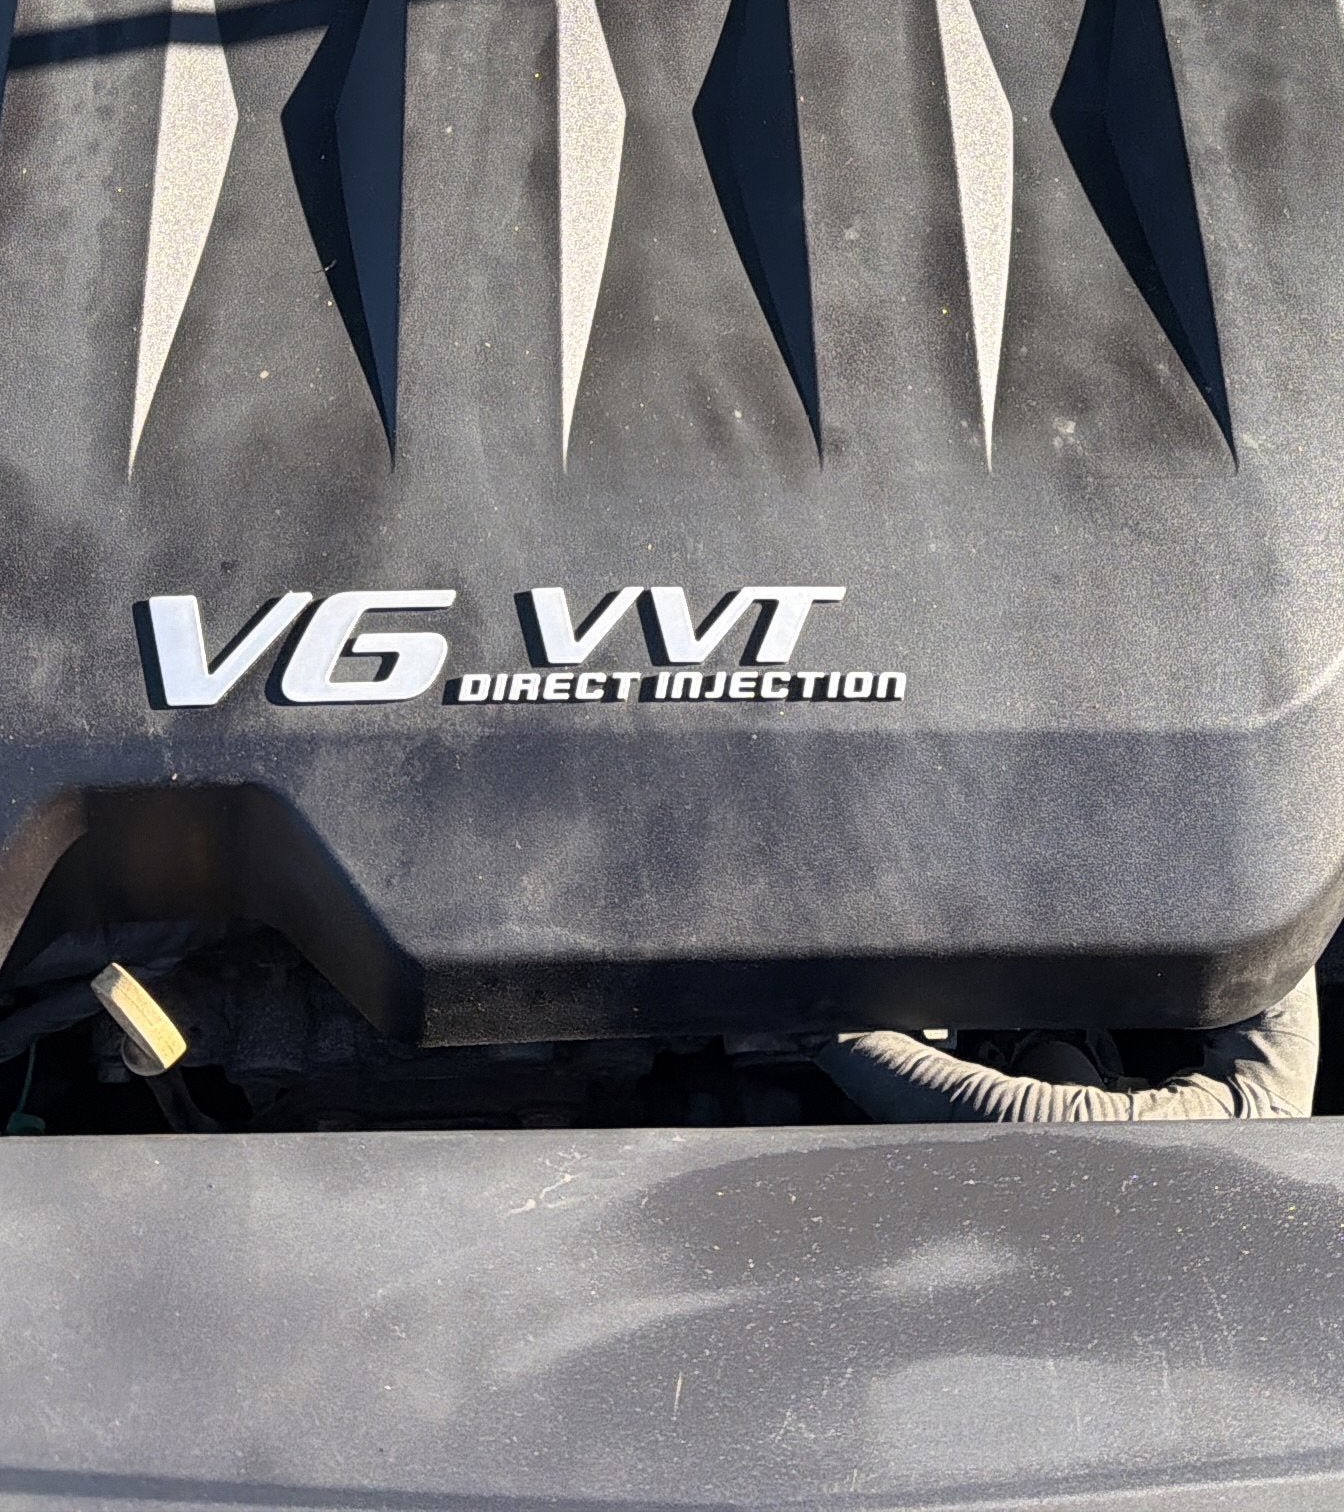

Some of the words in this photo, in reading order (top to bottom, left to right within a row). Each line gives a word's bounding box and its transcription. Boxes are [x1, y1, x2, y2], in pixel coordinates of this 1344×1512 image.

[148, 589, 457, 706] V6
[530, 585, 847, 665] VVT
[457, 671, 642, 702] DIRECT
[656, 670, 907, 701] INJECTION
